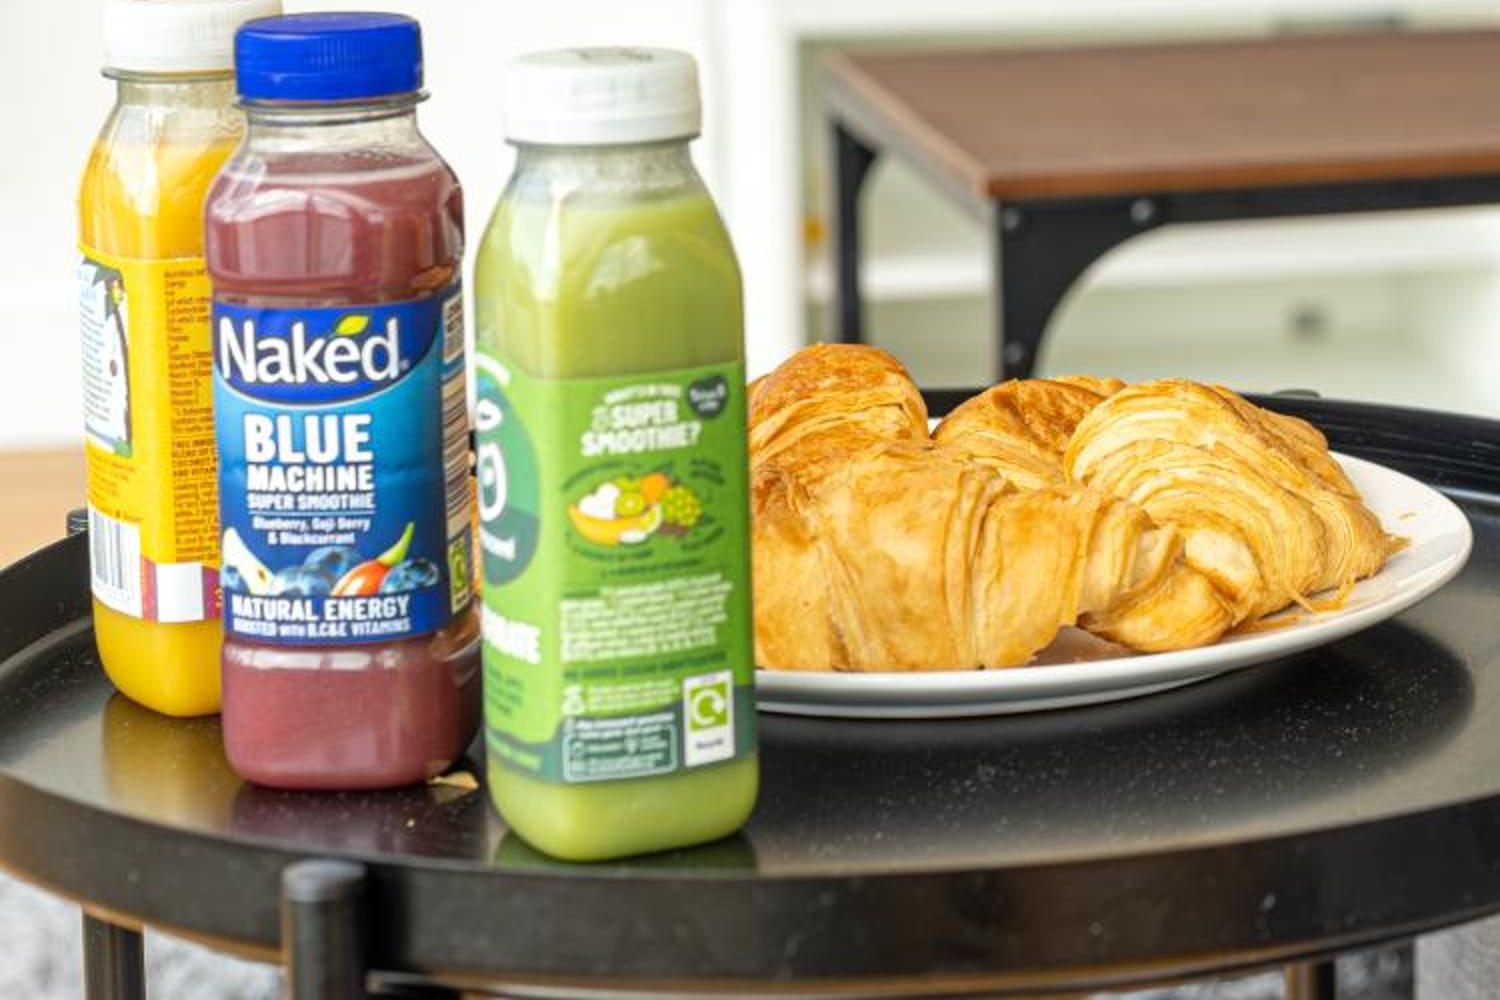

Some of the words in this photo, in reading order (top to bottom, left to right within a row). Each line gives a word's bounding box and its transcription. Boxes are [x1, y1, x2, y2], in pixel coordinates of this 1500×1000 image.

[219, 316, 399, 383] Naked
[610, 400, 678, 429] SUPER
[244, 413, 374, 463] BLUE
[581, 421, 702, 457] SMOOTHIE?
[247, 464, 374, 491] MACHINE
[247, 492, 295, 509] SUPER
[297, 492, 375, 510] SMOOTHIE
[232, 595, 319, 621] NATURAL
[325, 594, 410, 621] ENERGY
